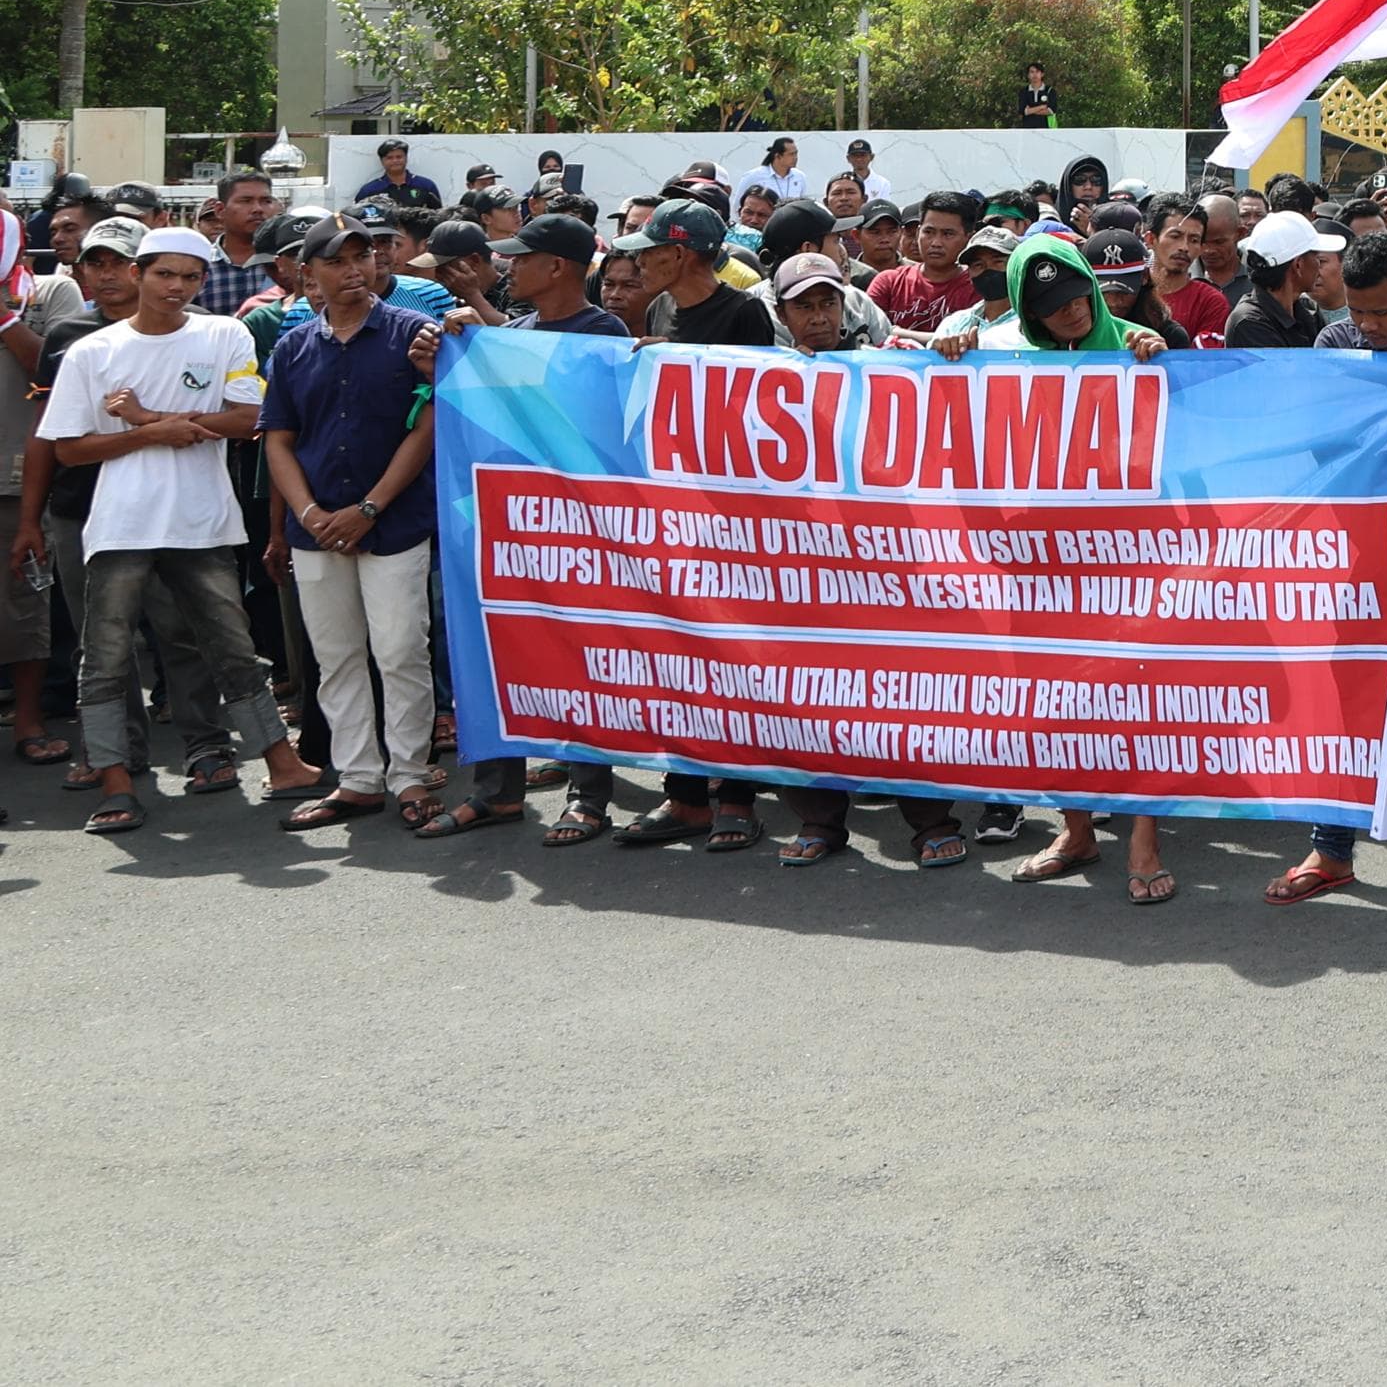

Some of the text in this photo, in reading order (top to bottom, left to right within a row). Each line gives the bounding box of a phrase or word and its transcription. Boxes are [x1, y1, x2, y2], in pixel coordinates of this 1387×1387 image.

[652, 362, 1163, 491] AKSI DAMAI
[508, 494, 1350, 570] KEJARI HULU SUNGAI UTARA SELIDIK USUT BERBAGAI INDIKASI
[493, 540, 1381, 622] KORUPSI YANG TERJADI DI DINAS KESEHATAN HULU SUNGAI UTARA
[583, 646, 1270, 725] KEJARI HULU SUNGAI UTARA SELIDIKI USUT BERBAGAI INDIKASI
[506, 682, 1381, 779] KORUPSI YANG TERJADI DI RUMAH SAKIT PEMBALAH BATUNG HULU SUNGAI UTARA
